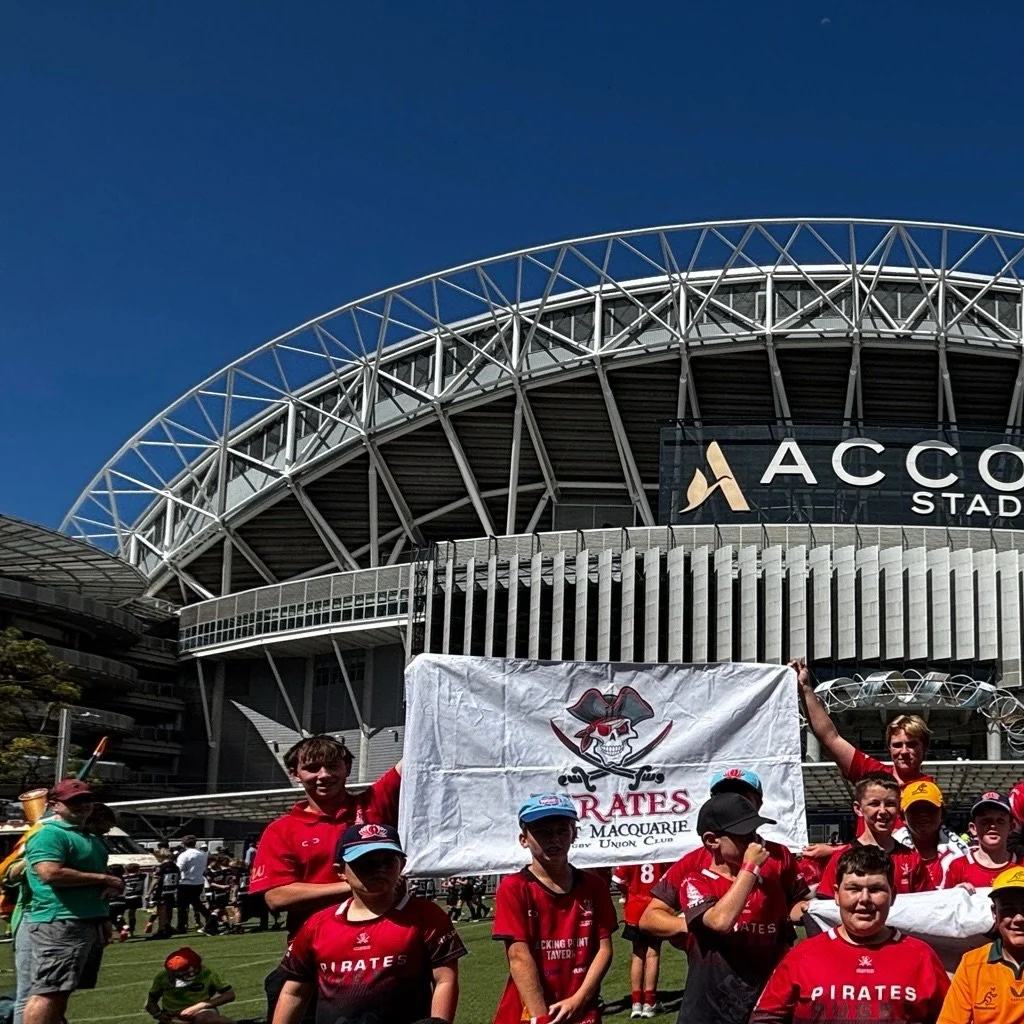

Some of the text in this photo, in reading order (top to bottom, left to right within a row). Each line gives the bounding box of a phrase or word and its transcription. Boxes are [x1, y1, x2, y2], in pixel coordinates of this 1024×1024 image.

[570, 788, 692, 823] RATES
[590, 820, 691, 839] MACQUARIE
[640, 863, 655, 884] 8
[811, 985, 917, 1002] PIRATES
